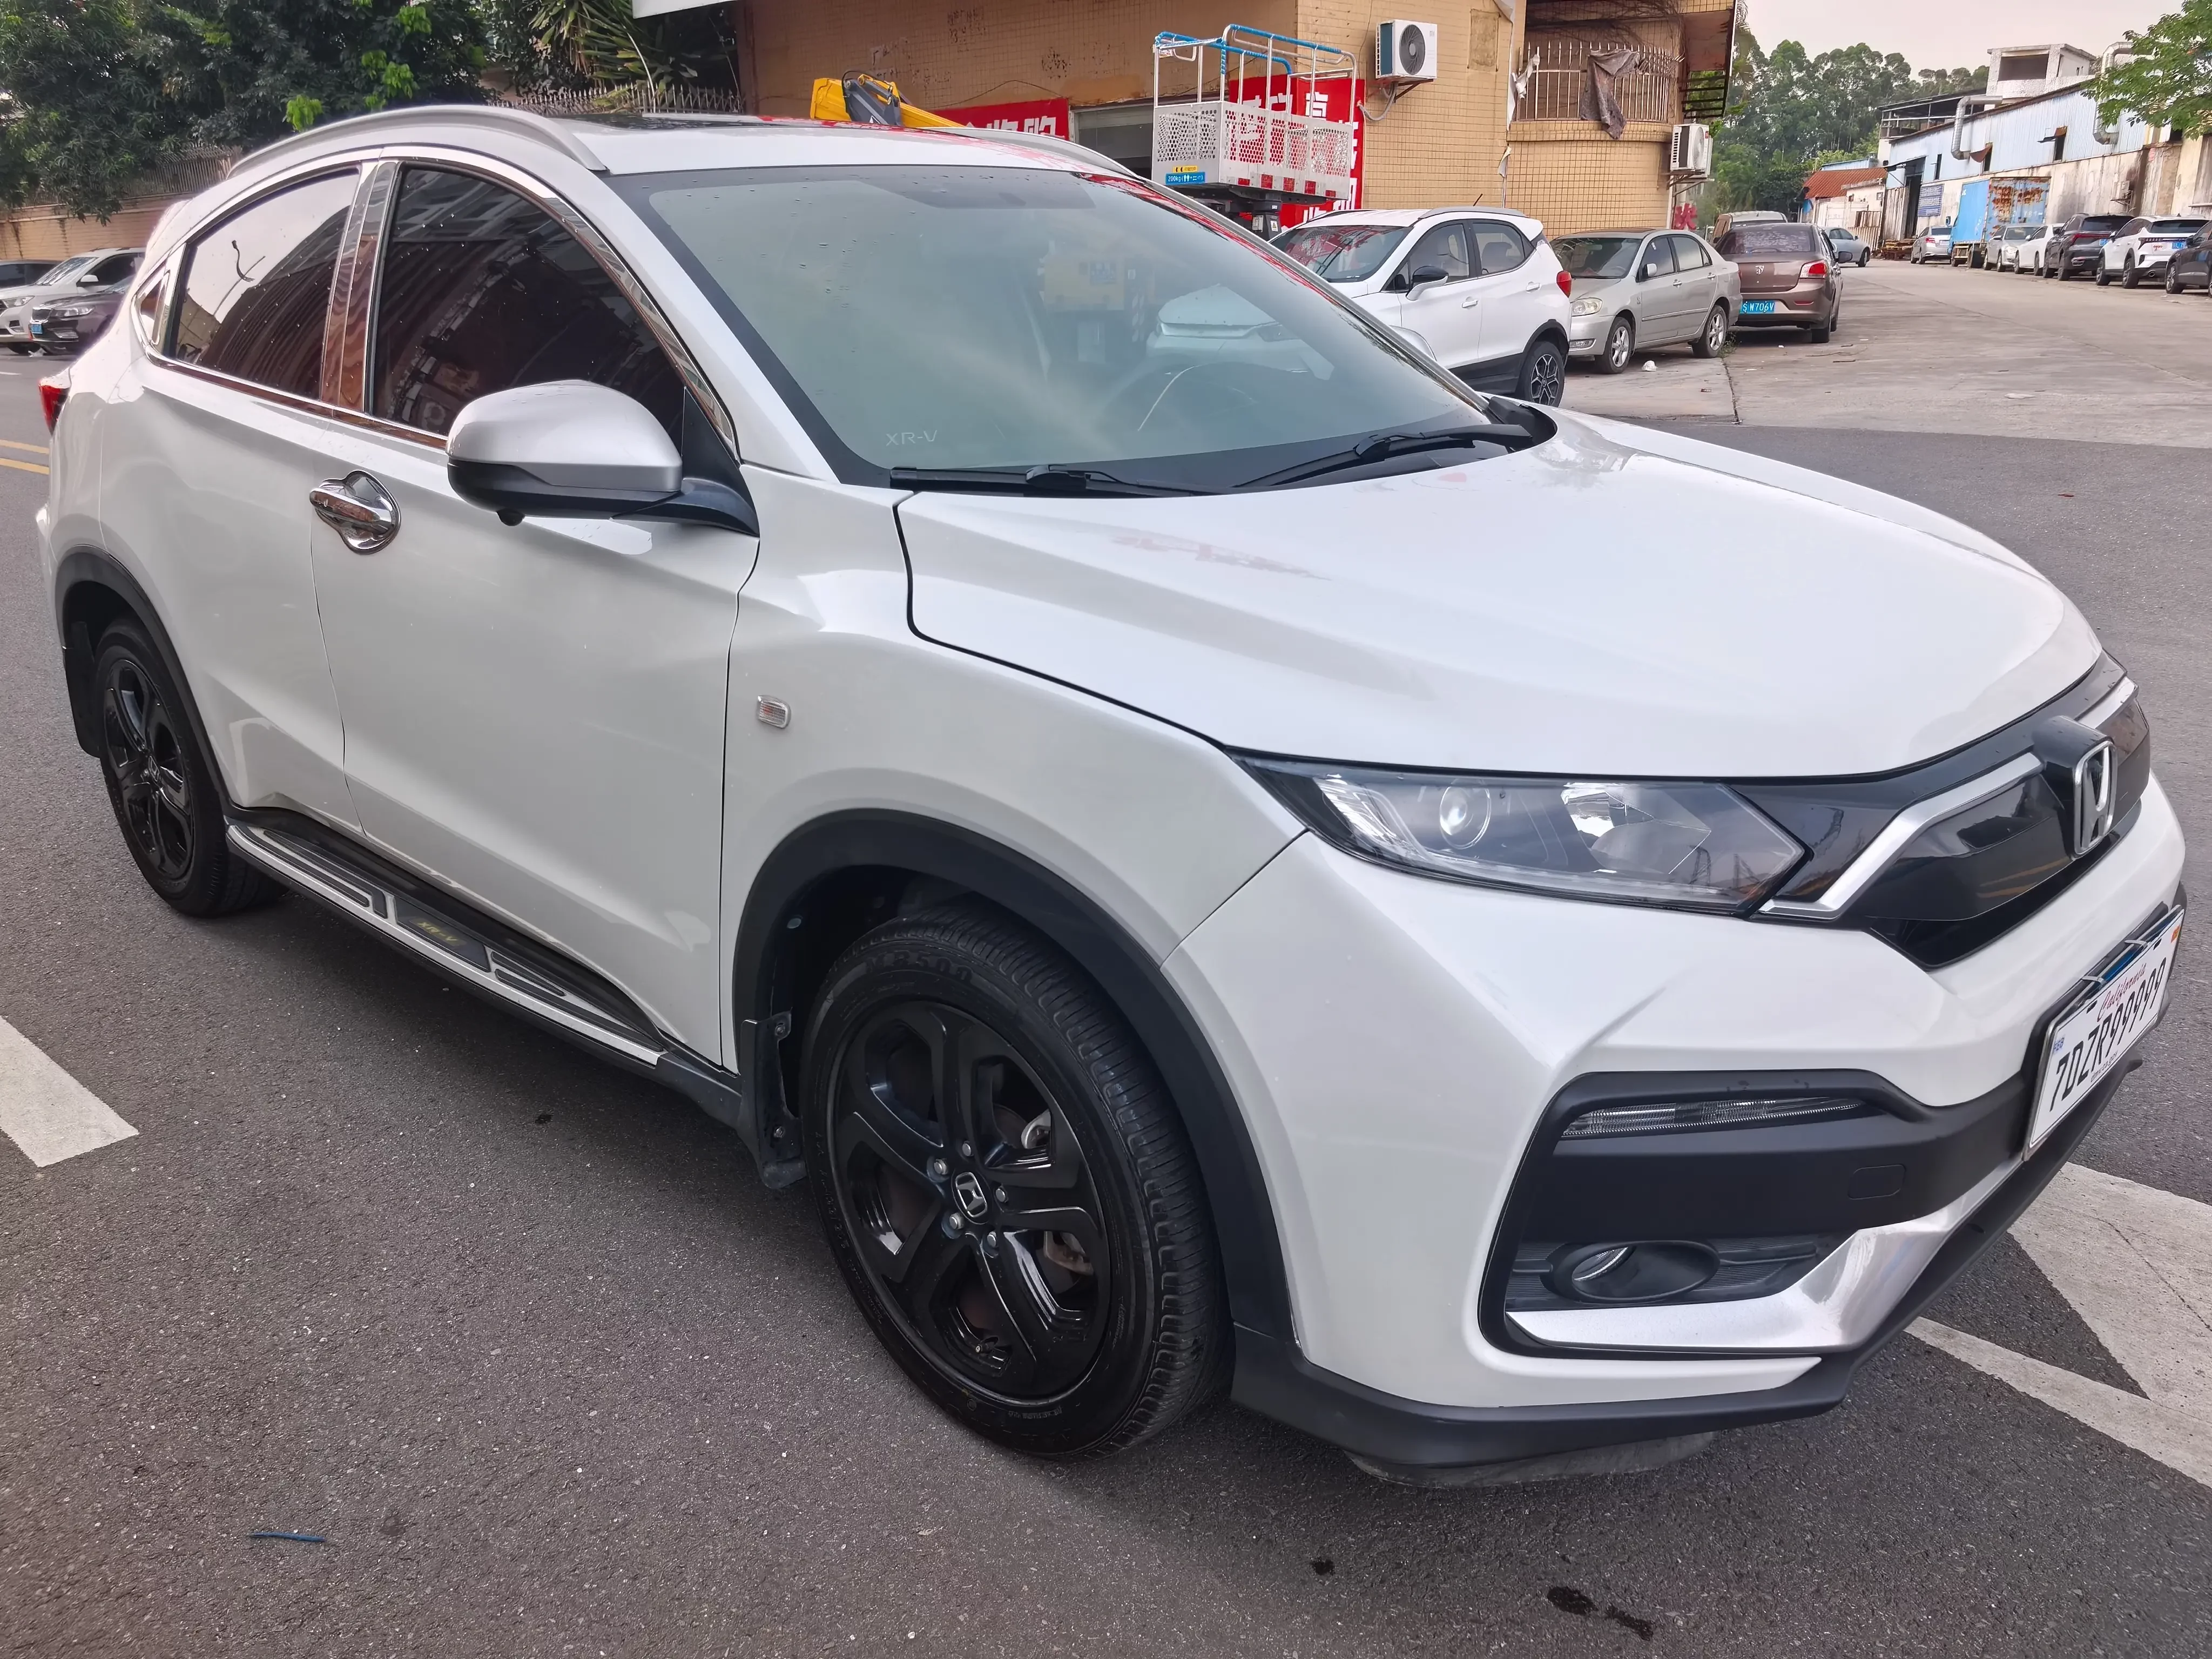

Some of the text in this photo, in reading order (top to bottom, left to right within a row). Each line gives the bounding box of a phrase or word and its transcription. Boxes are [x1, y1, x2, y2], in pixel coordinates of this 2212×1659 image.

[886, 430, 938, 447] XR-V
[416, 921, 460, 942] XR-V
[2096, 962, 2147, 1023] California
[2049, 957, 2167, 1112] 7DZR99999
